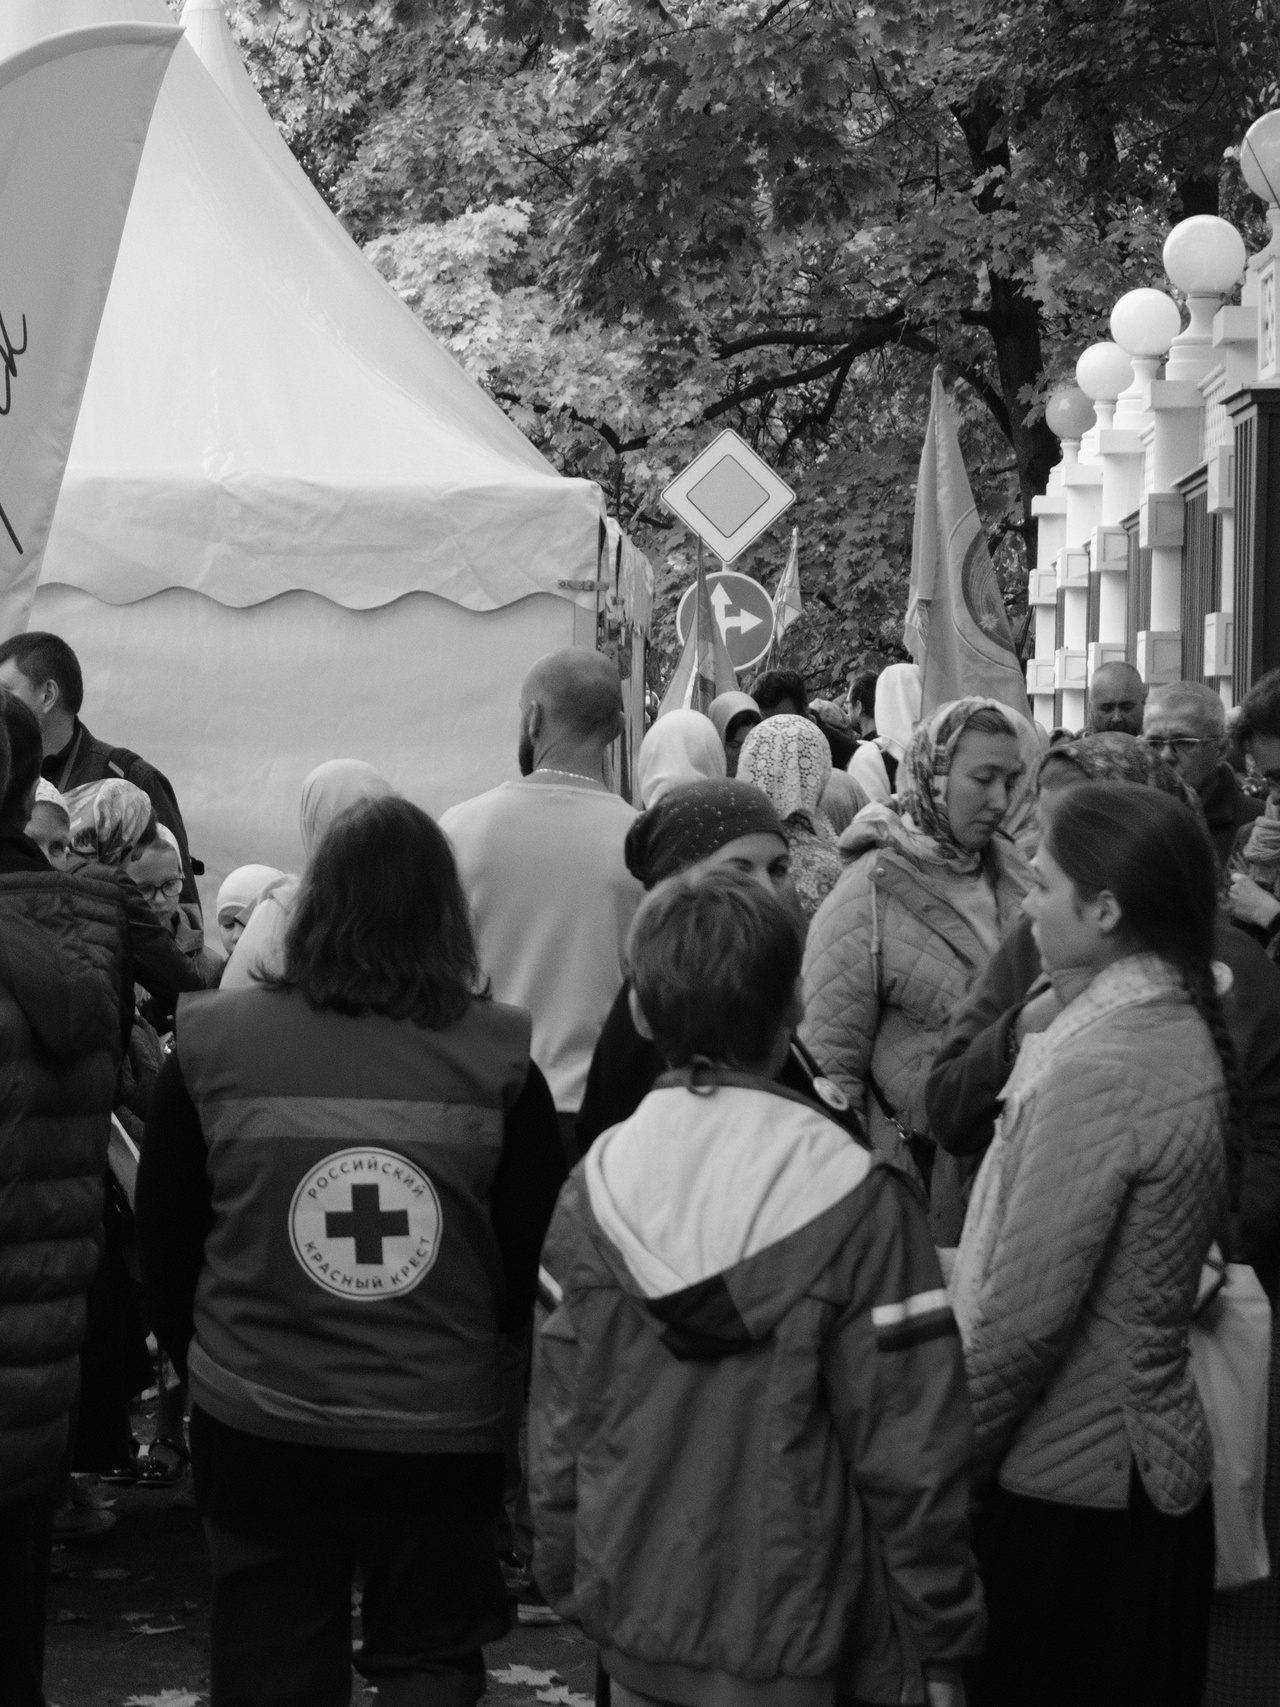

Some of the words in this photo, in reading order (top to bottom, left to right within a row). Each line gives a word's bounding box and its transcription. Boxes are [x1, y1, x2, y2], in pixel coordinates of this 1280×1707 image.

[307, 1156, 427, 1200] РОССИЙСКИЙ
[304, 1240, 384, 1289] КРАСНЫЙ
[390, 1236, 430, 1286] КРЕСТ
